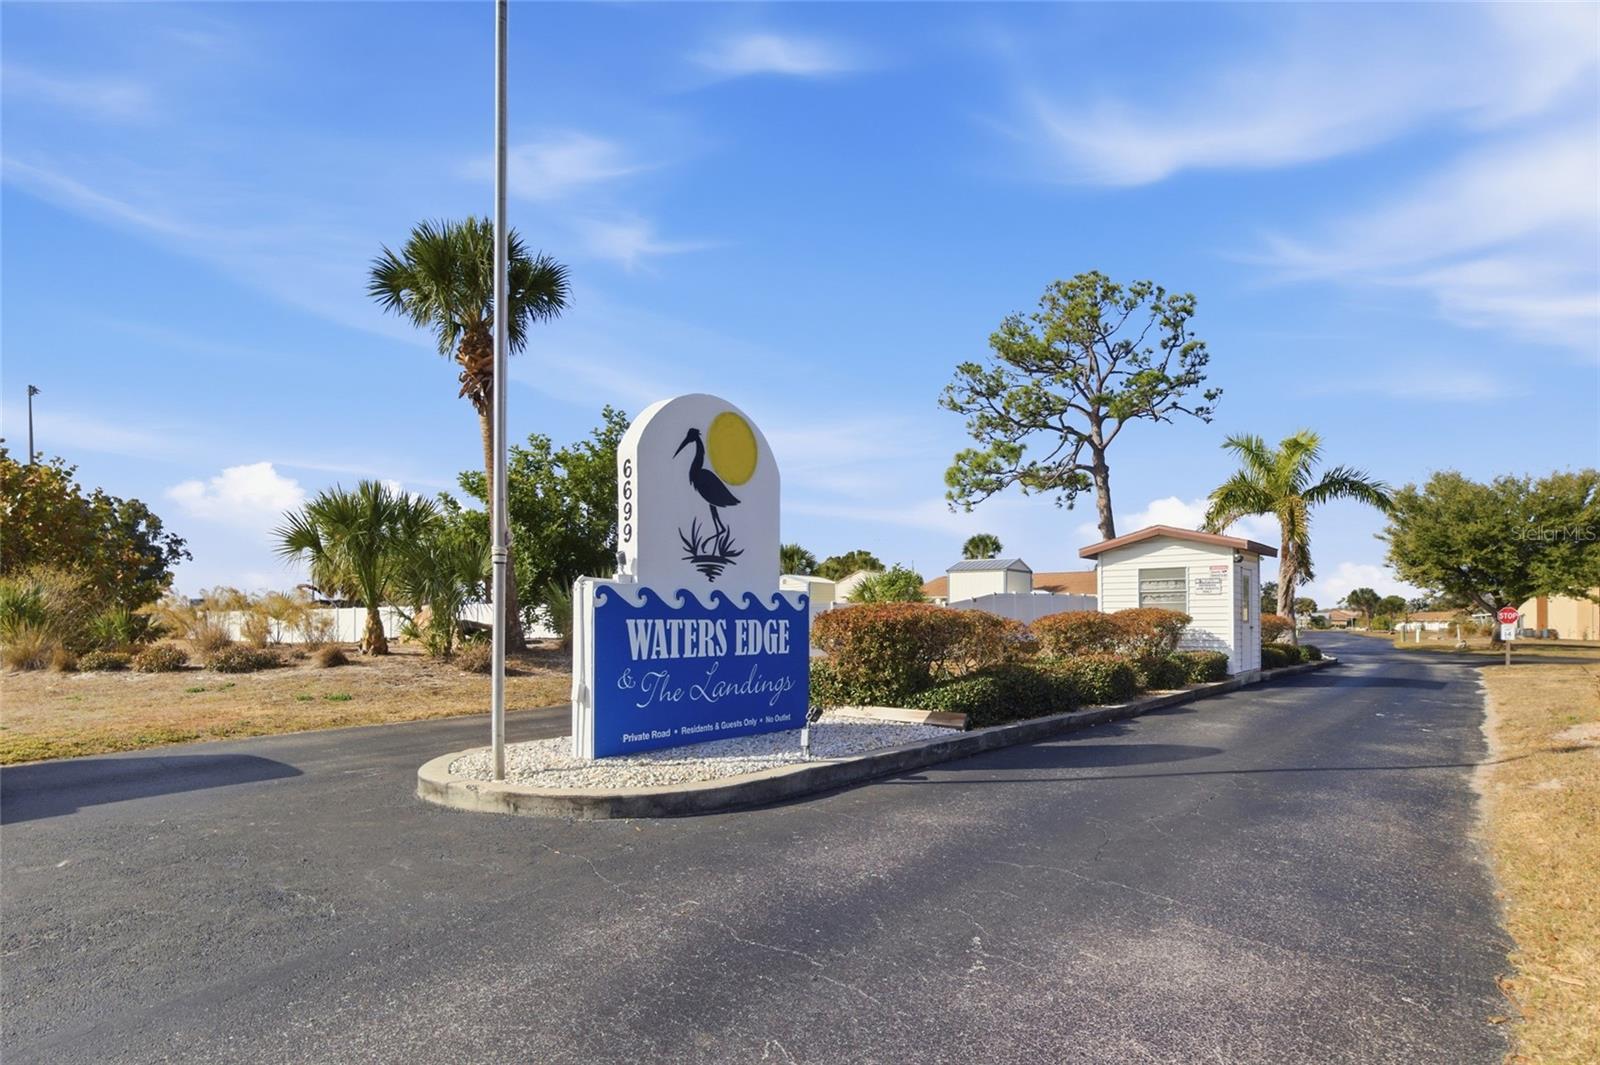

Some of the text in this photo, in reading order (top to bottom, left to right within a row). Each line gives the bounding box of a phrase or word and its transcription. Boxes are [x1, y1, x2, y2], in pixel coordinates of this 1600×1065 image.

[623, 459, 632, 543] 6699
[1499, 612, 1519, 620] STOP
[626, 619, 790, 660] WATERS EDGE
[617, 661, 796, 708] & The Landings
[622, 713, 791, 743] Private Road Residents & Guests Only No Outlet
